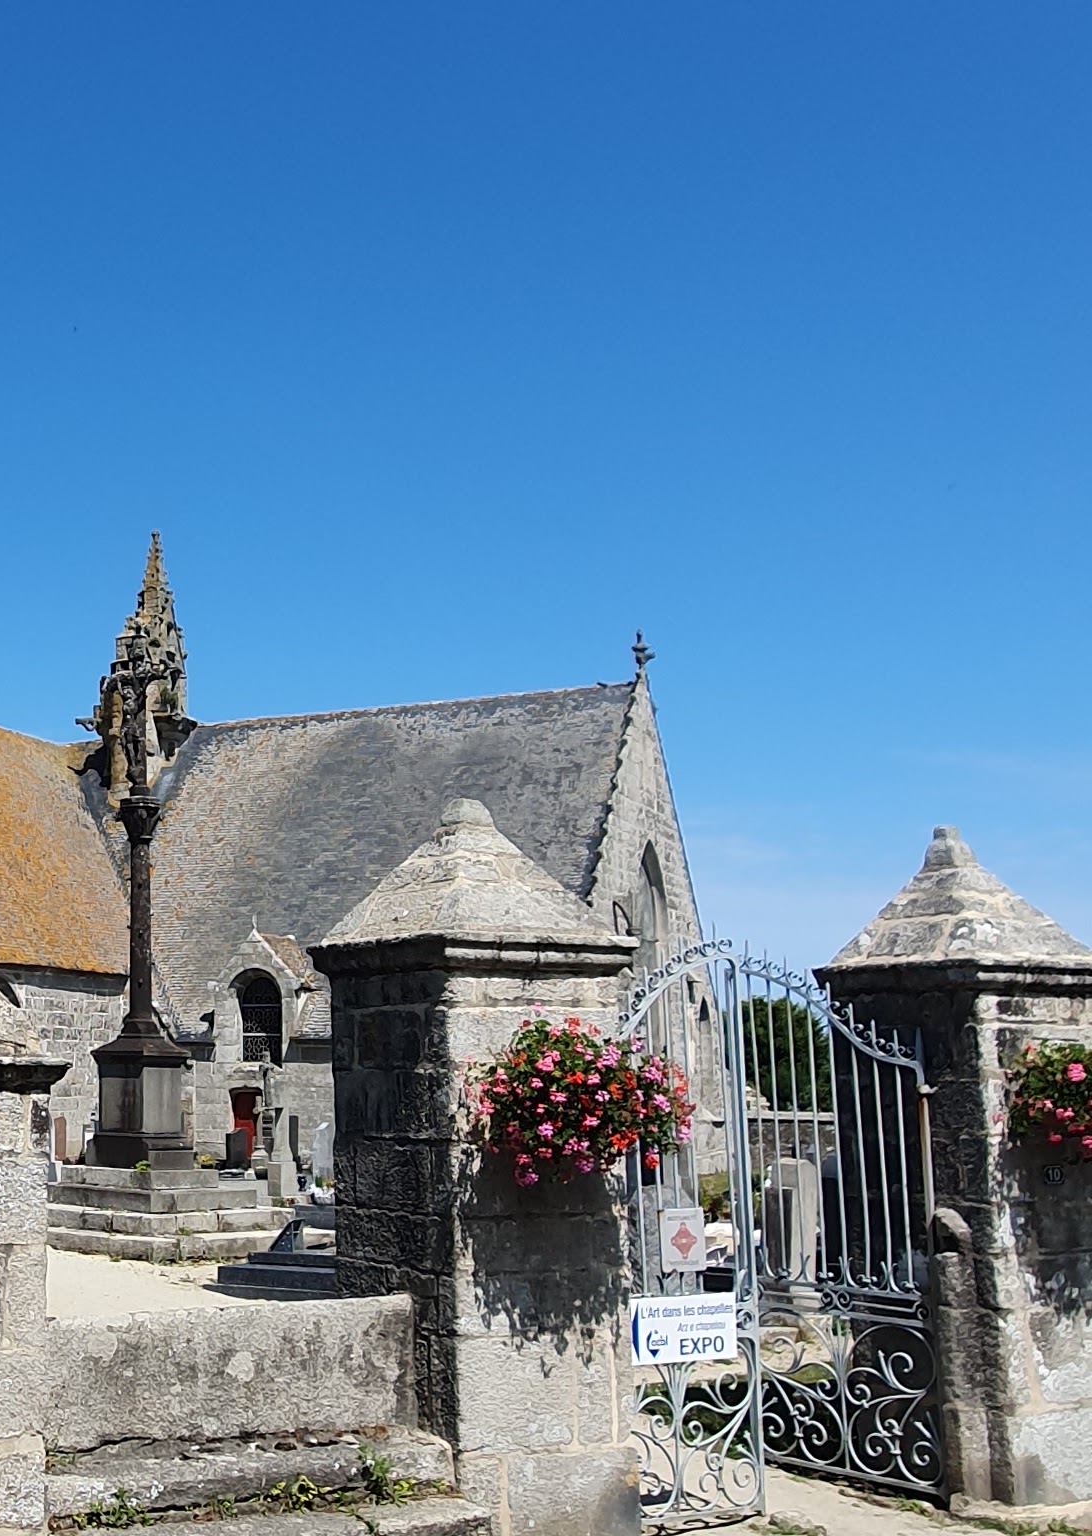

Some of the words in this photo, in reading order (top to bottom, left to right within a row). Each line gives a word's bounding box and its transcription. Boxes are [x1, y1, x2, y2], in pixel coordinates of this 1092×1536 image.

[1048, 1168, 1061, 1181] 10
[640, 1306, 660, 1319] L'Art
[662, 1306, 681, 1318] dans
[683, 1305, 695, 1316] les
[697, 1303, 734, 1315] chapelles
[679, 1335, 725, 1355] EXPO
